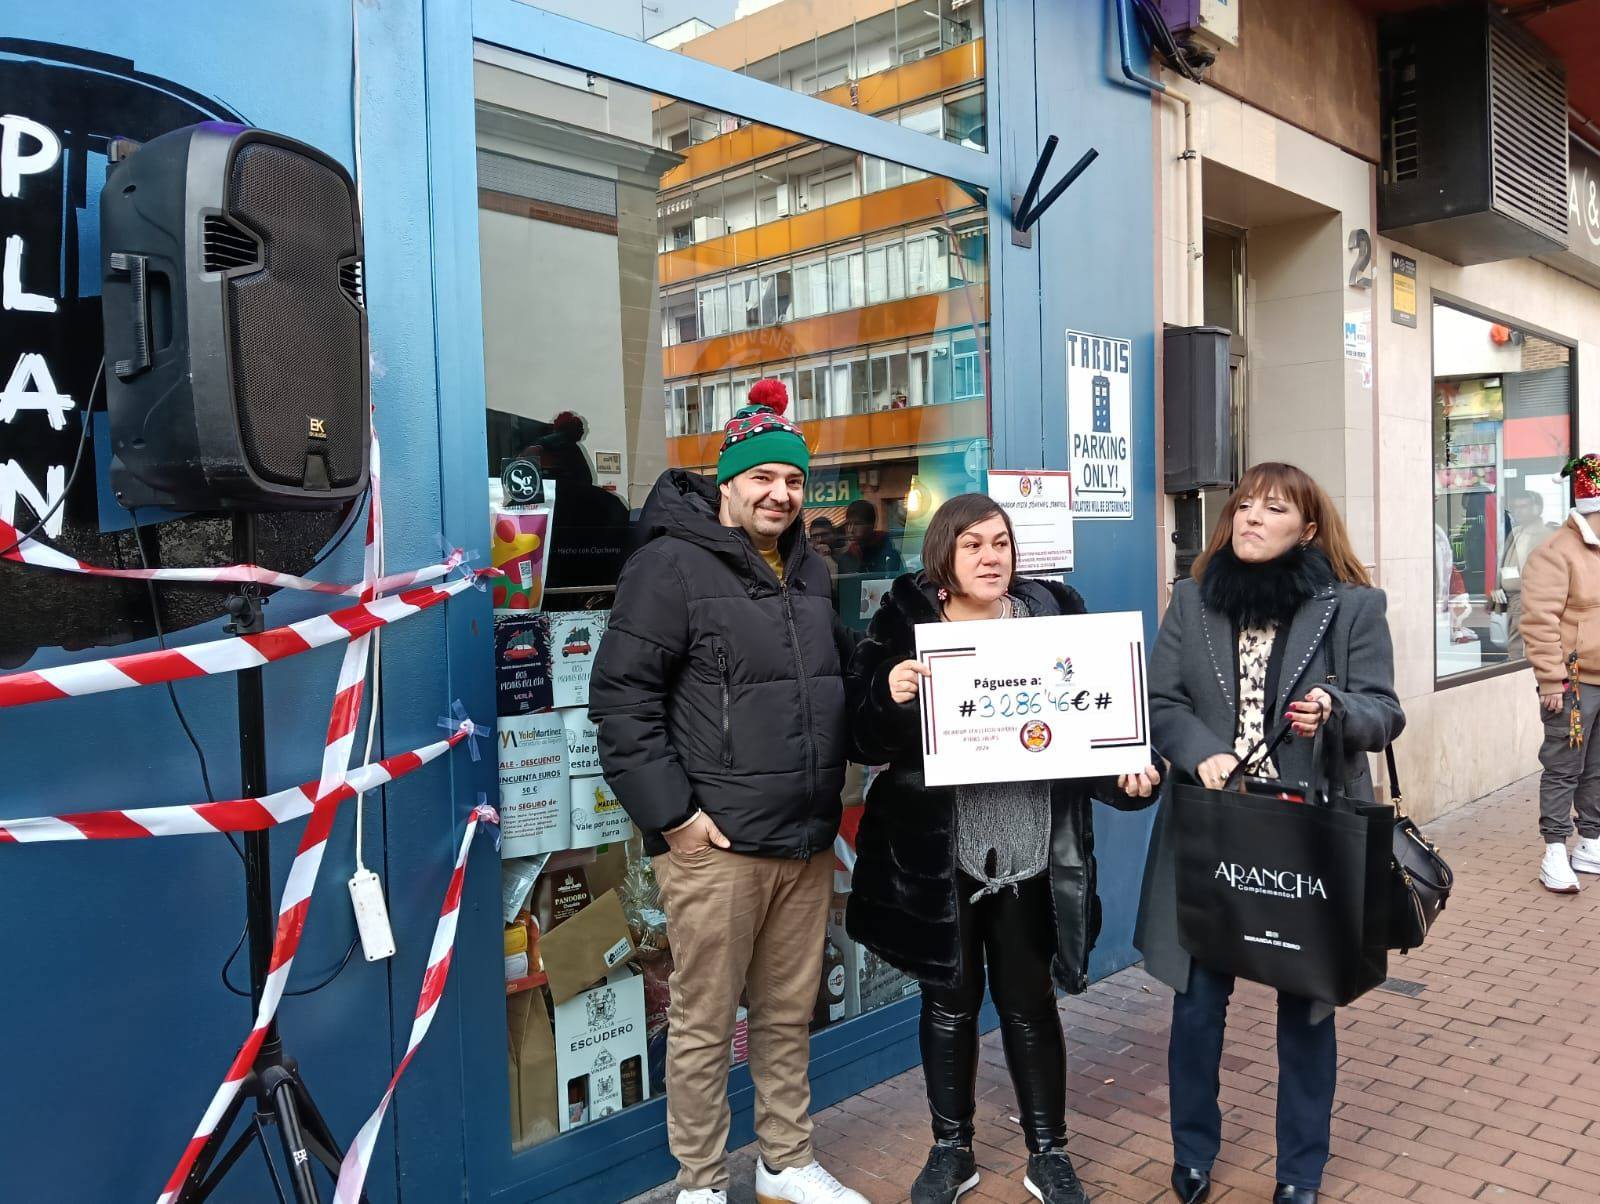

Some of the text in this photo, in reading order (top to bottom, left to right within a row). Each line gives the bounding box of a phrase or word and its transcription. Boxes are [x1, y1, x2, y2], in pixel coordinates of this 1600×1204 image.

[1348, 228, 1373, 290] 2
[1068, 334, 1129, 374] TARDIS
[1074, 433, 1127, 460] PARKING
[511, 469, 534, 496] Sg
[1083, 463, 1119, 488] ONLY!
[1100, 501, 1105, 513] BE
[1106, 501, 1130, 513] EXTERMINATED
[974, 676, 1027, 691] Páguese
[1030, 678, 1042, 687] a:
[569, 744, 590, 754] Vale
[500, 761, 514, 769] ALE
[521, 755, 561, 767] DESCUENTO
[499, 770, 561, 784] INCUENTA EUROS
[518, 800, 547, 810] SEGURO
[576, 822, 592, 831] Vale
[594, 820, 605, 830] por
[1215, 861, 1327, 899] ARANCHA
[1238, 884, 1295, 899] Complementos
[555, 893, 587, 906] PANDORO
[570, 1023, 634, 1052] ESCUDERO
